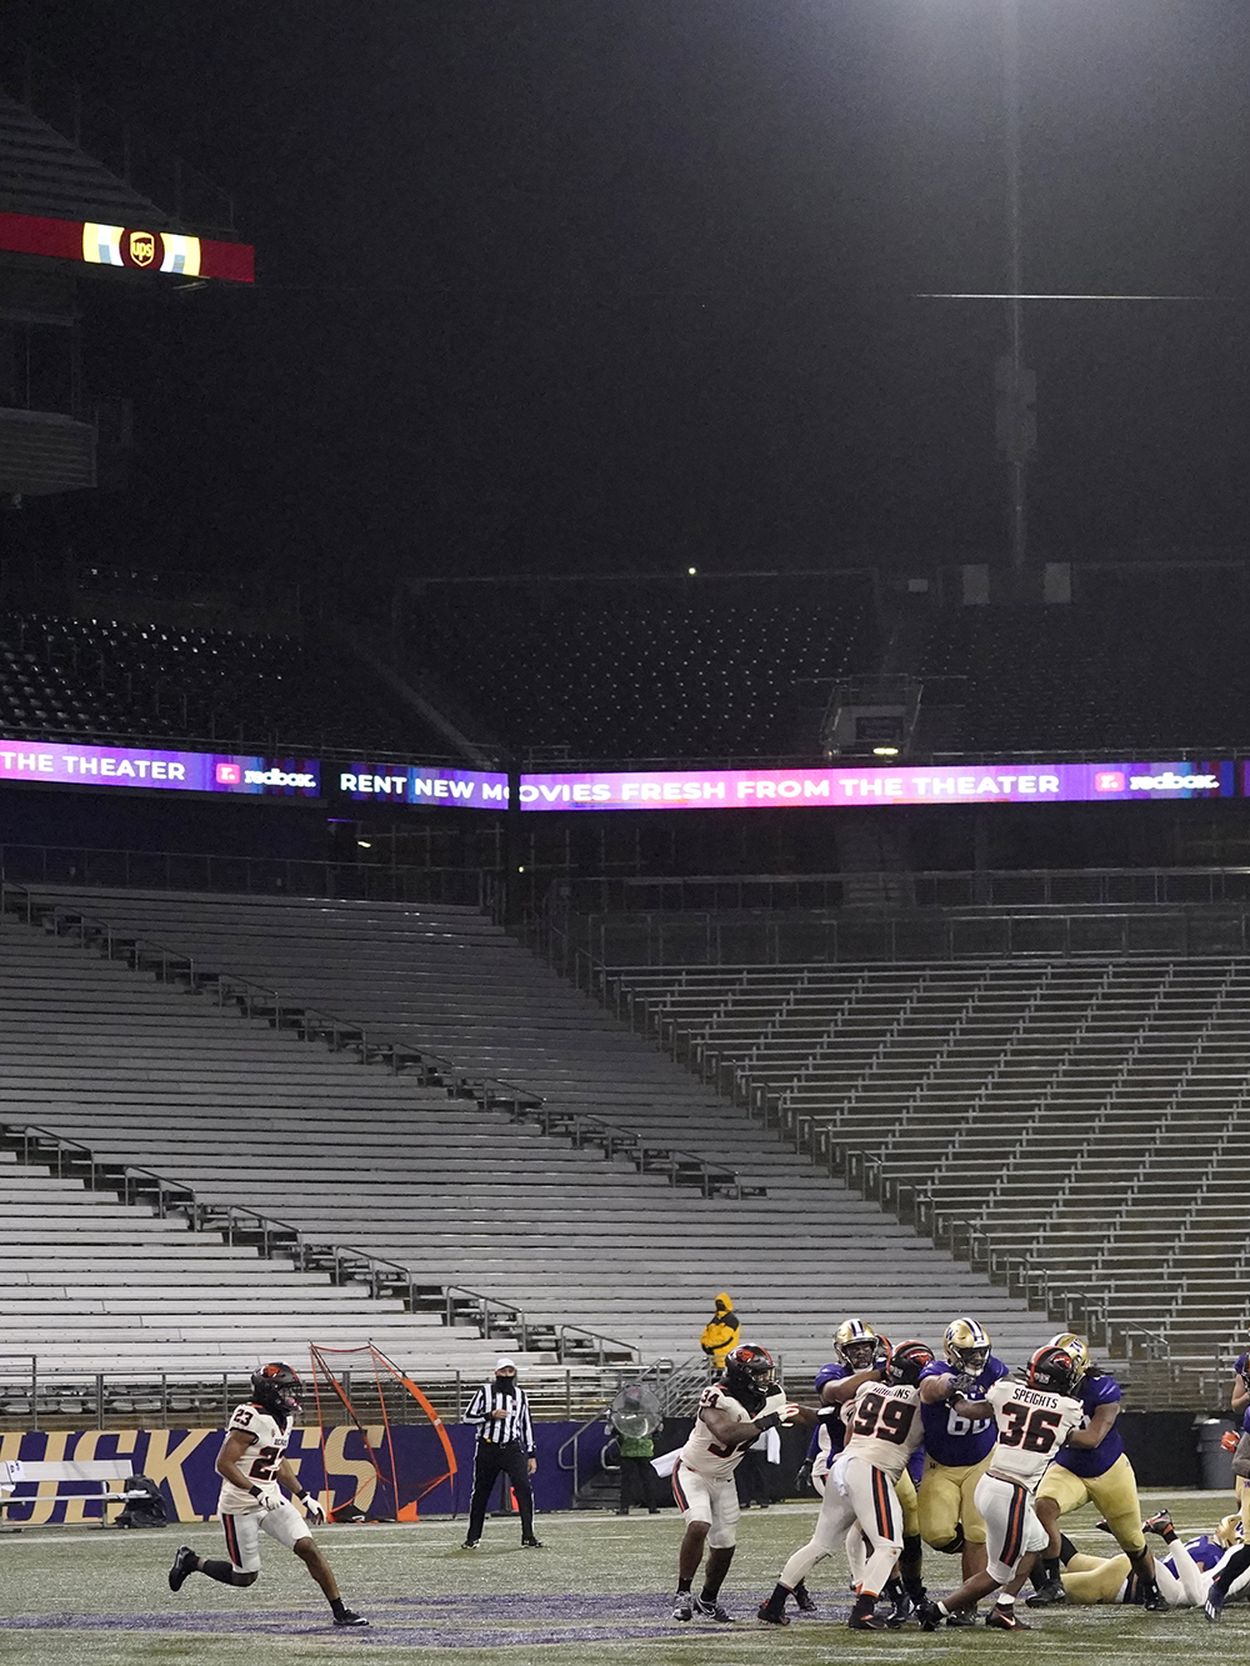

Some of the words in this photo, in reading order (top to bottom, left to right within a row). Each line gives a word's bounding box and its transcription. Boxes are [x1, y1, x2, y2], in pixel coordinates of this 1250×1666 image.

[0, 752, 54, 773] THE
[62, 755, 186, 781] THEATER
[340, 773, 407, 795] RENT
[415, 778, 475, 799] NEW
[621, 781, 726, 801] FRESH
[737, 779, 830, 799] FROM
[839, 777, 904, 797] THE
[912, 775, 1060, 795] THEATER
[1011, 1387, 1059, 1410] SPEIGHTS
[233, 1408, 254, 1427] 23
[852, 1391, 918, 1446] 99
[1000, 1401, 1063, 1454] 36
